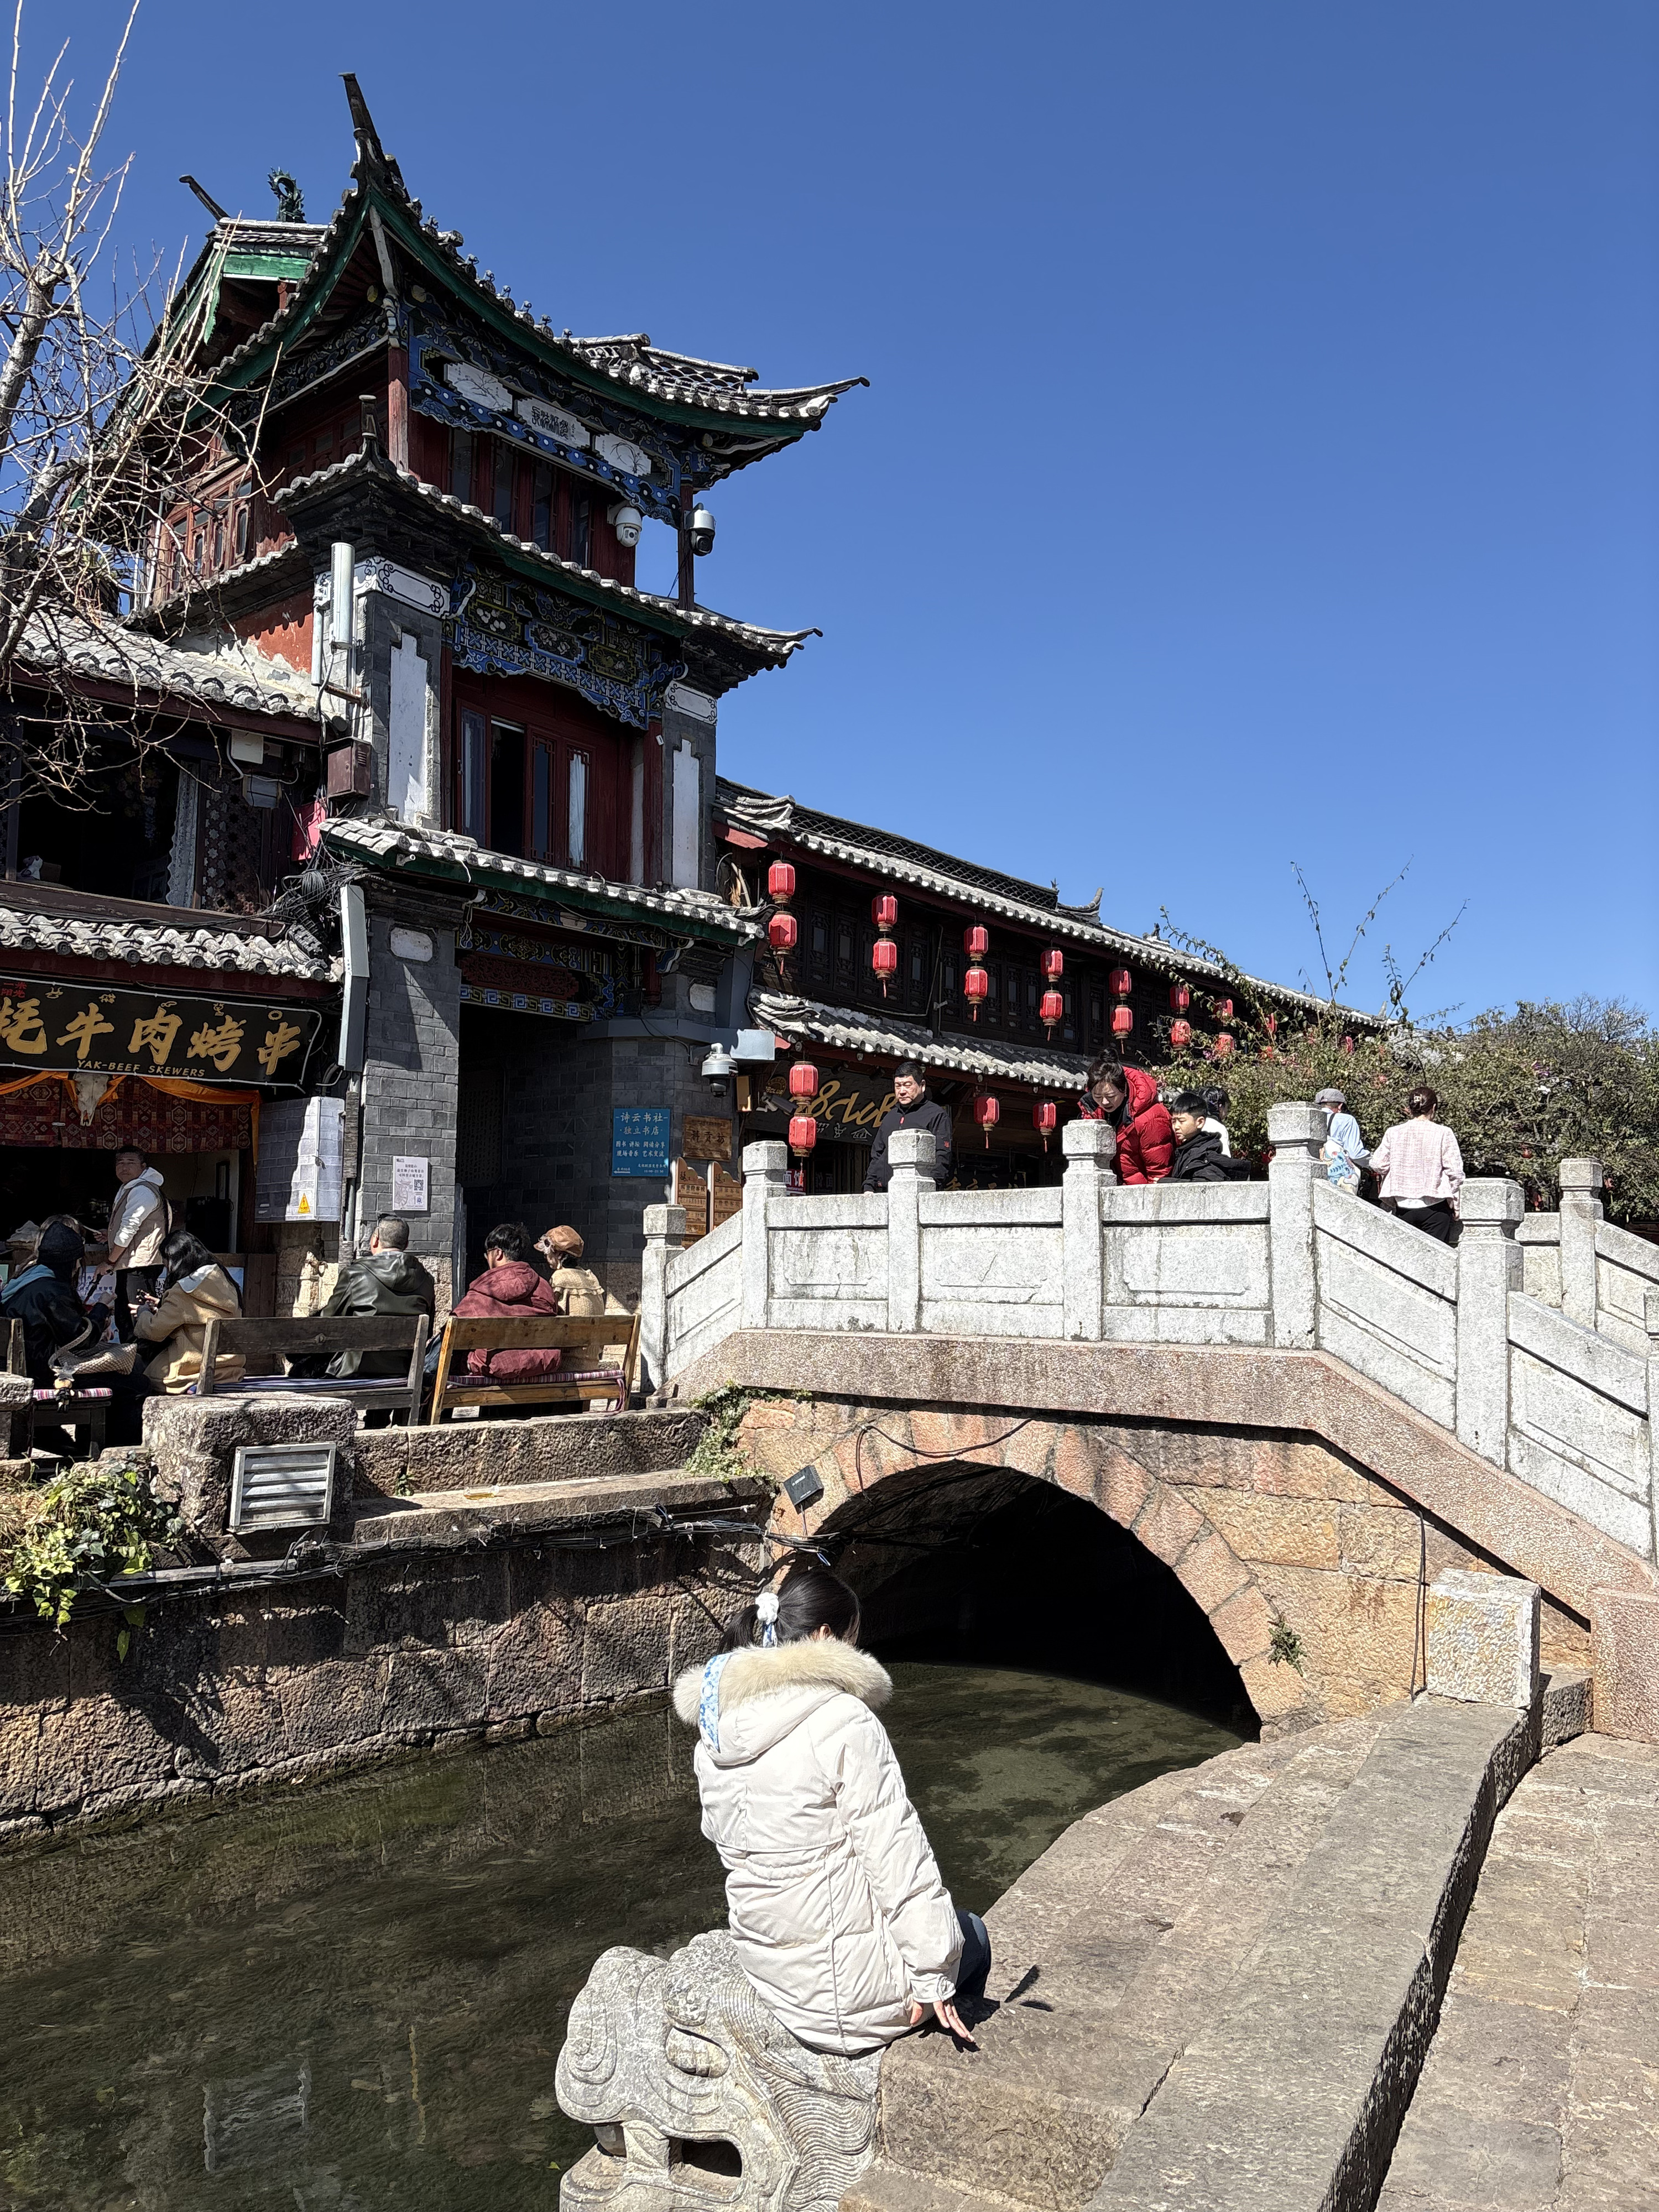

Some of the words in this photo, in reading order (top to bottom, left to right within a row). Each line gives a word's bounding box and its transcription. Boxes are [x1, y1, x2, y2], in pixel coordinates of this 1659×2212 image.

[1, 988, 25, 998] 阳光
[0, 997, 301, 1076] 牦牛肉烤串
[77, 1060, 140, 1072] YAK-BEEF
[148, 1065, 205, 1077] SKEWERS
[620, 1112, 663, 1123] 诗云书社
[623, 1125, 659, 1135] 独立书店
